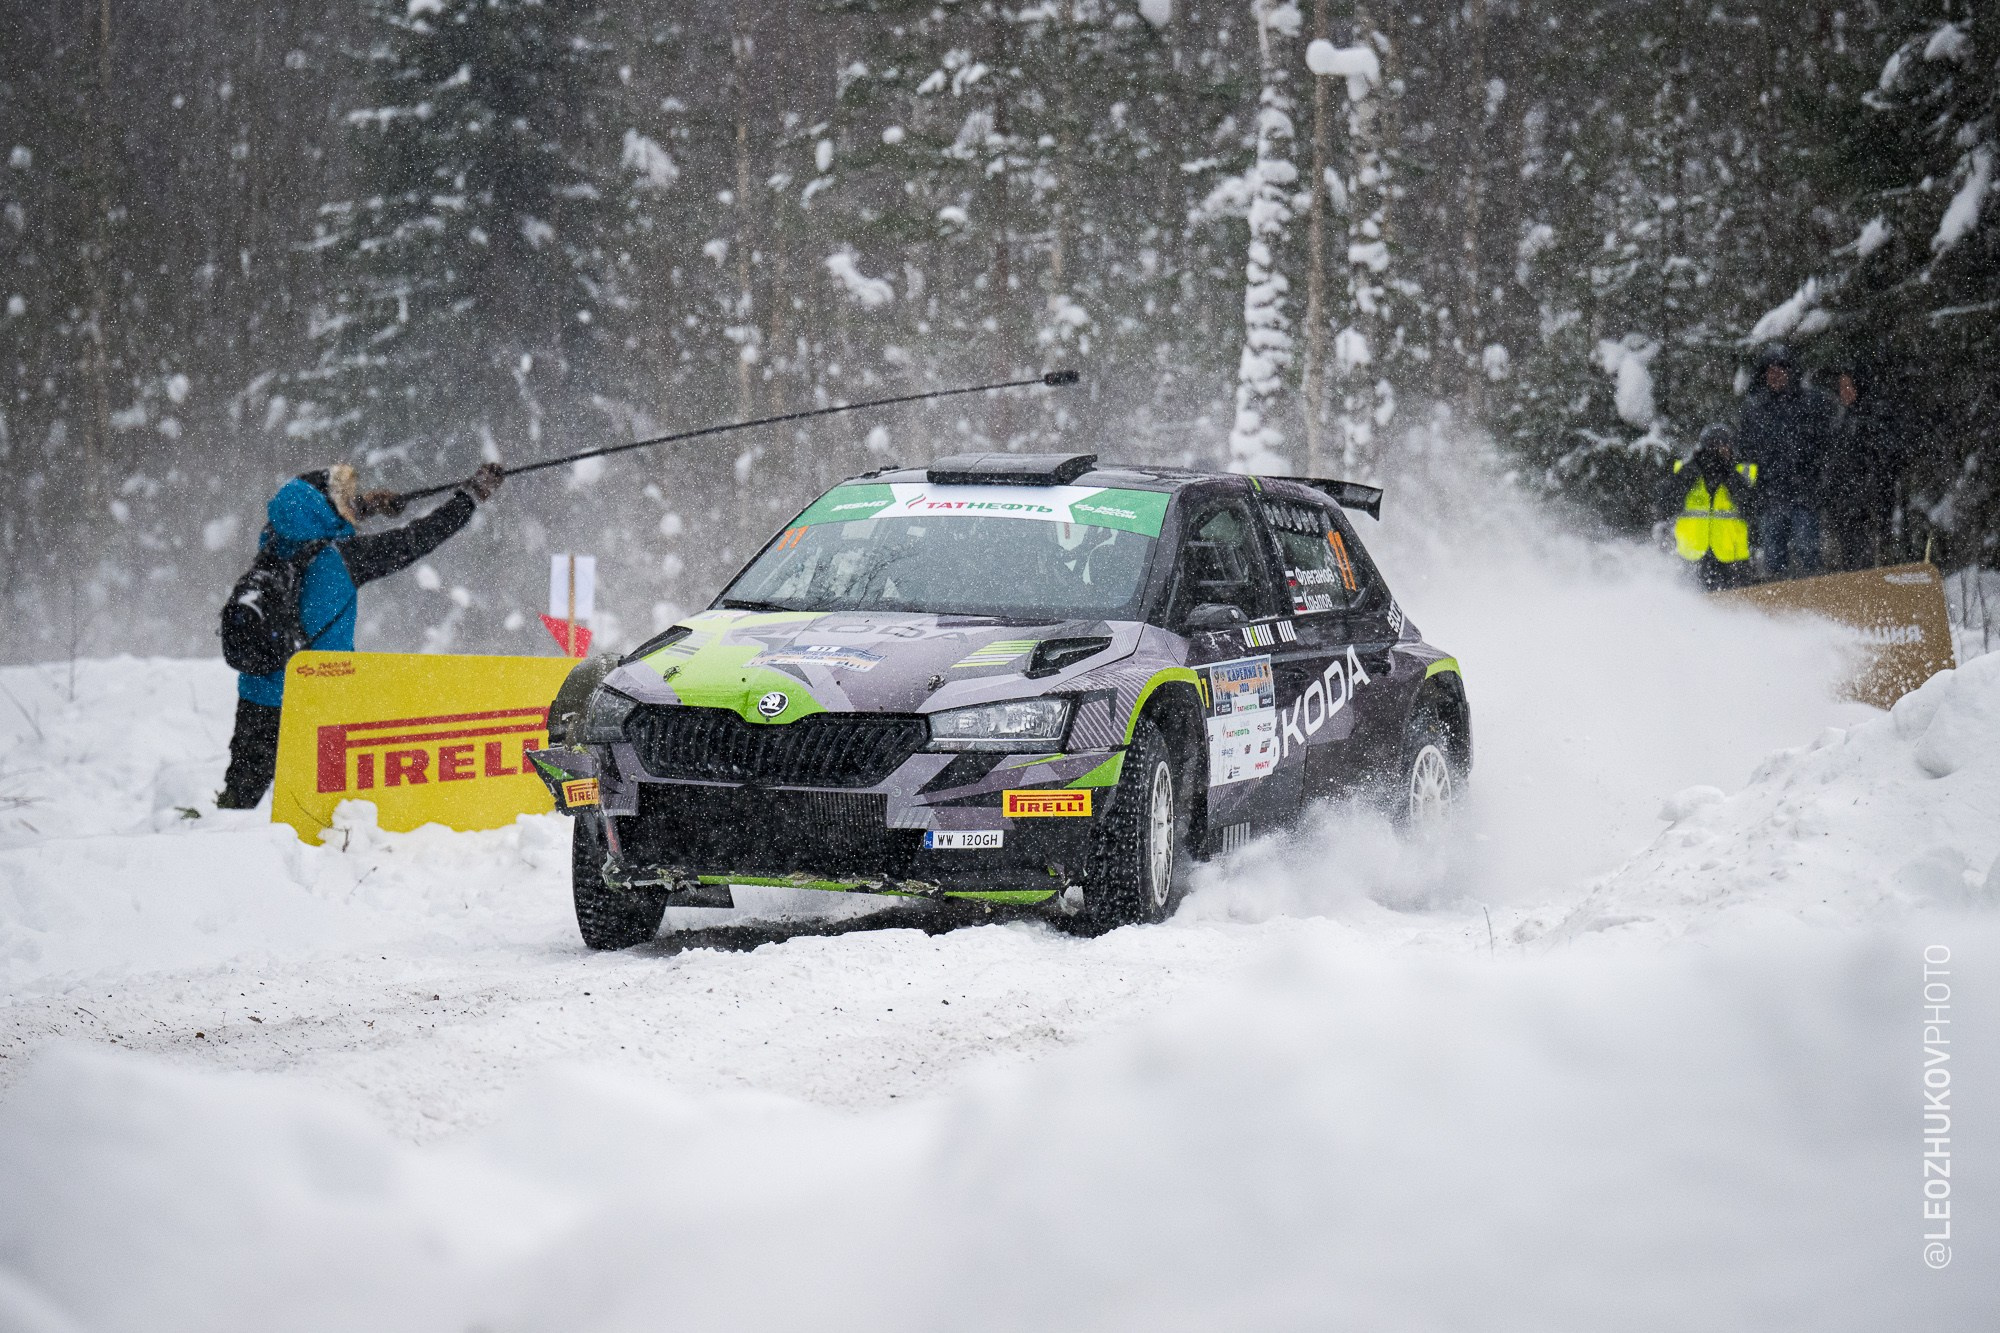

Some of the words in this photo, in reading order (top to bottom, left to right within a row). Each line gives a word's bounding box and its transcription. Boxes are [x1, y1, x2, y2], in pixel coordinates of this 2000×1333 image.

[926, 502, 1052, 513] ТАТНЕФТЬ
[777, 525, 809, 550] 11
[1328, 531, 1356, 591] 11
[1226, 728, 1250, 738] ТАТНЕФТЬ
[1009, 794, 1084, 813] PIRELLI
[938, 834, 953, 846] WW
[962, 834, 998, 846] 120GH
